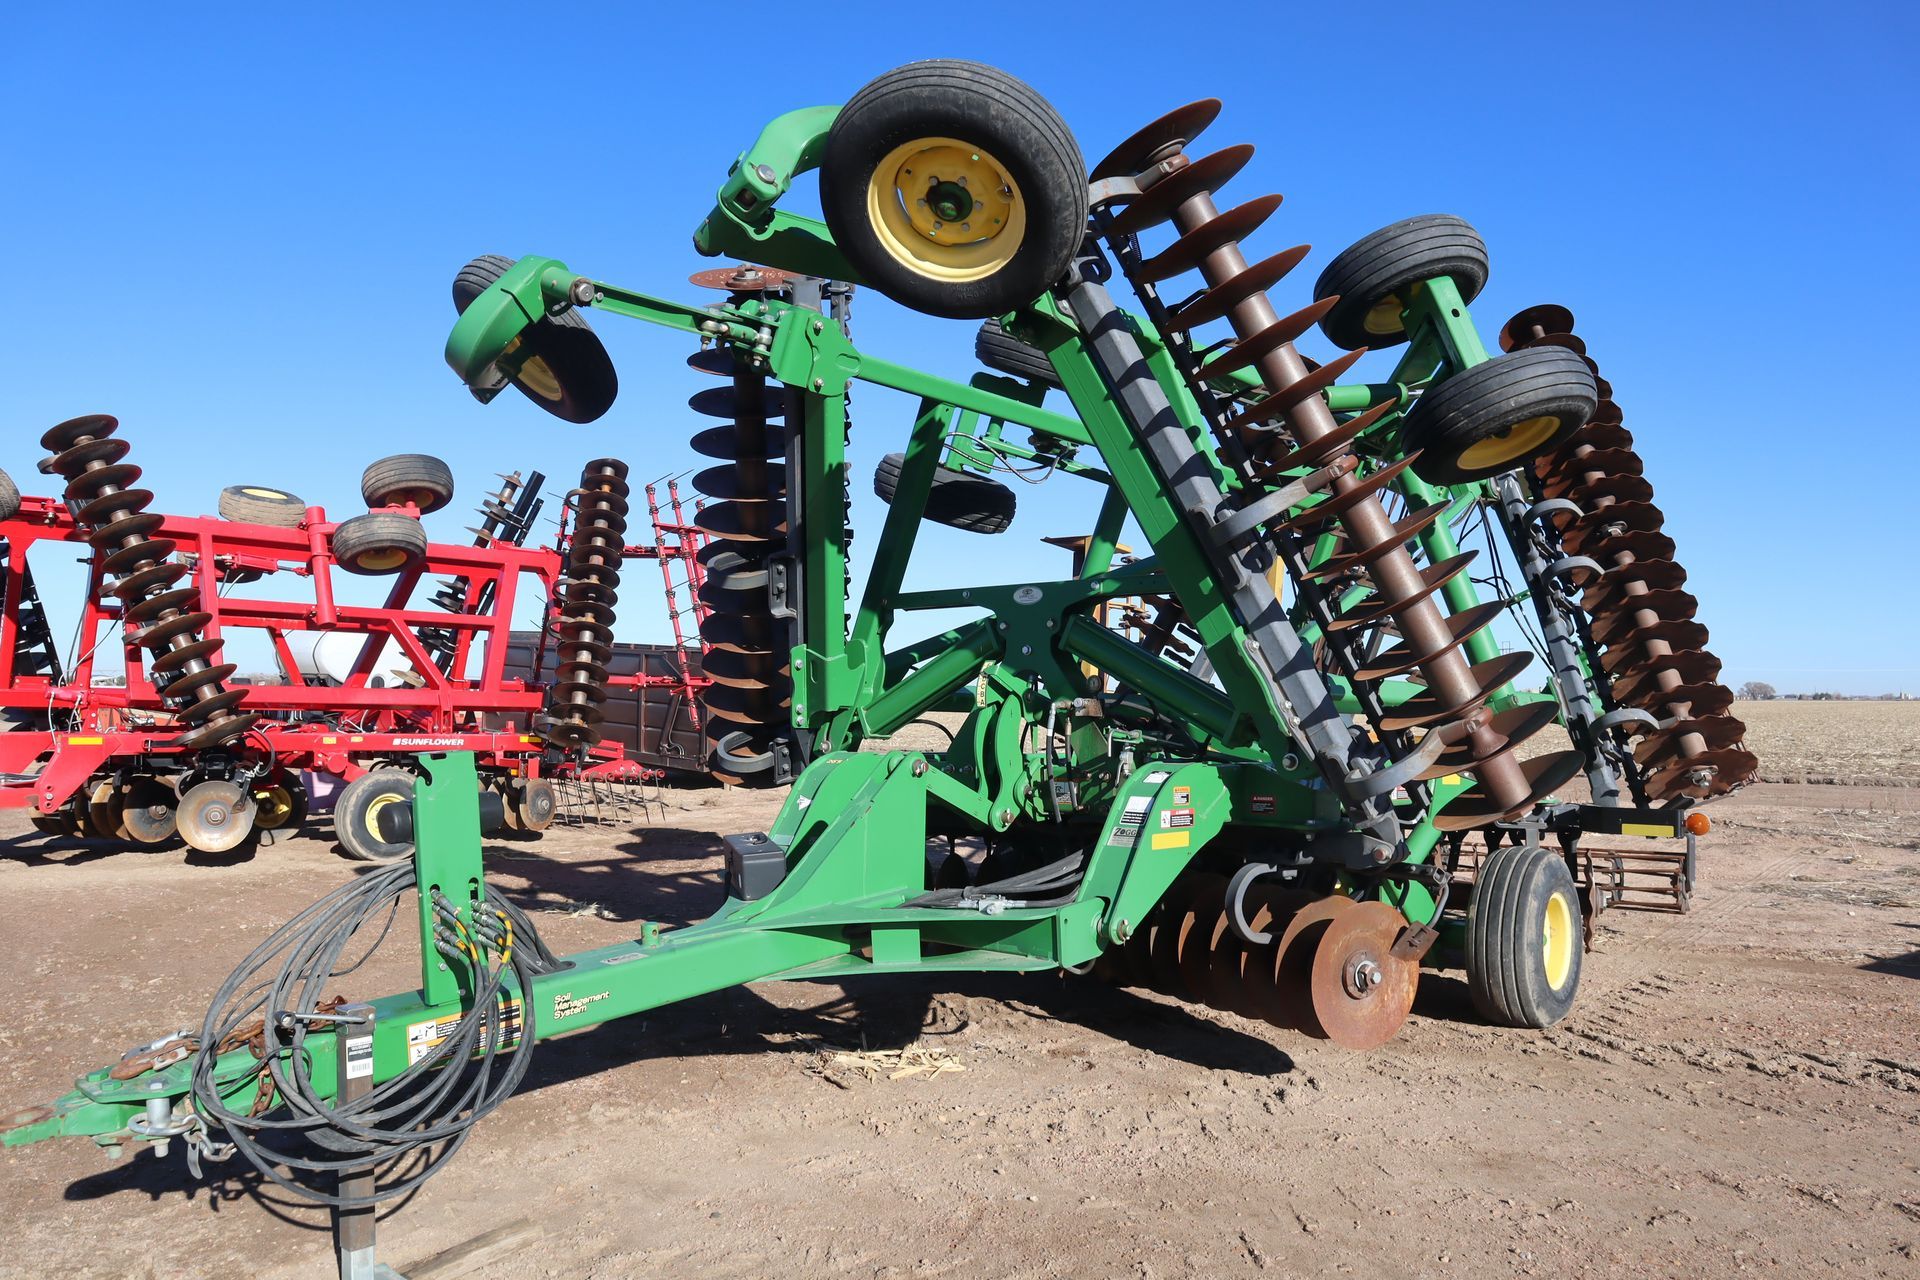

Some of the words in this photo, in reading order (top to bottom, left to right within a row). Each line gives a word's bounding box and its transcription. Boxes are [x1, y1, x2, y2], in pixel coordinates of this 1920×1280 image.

[401, 738, 464, 746] SUNFLOWER
[554, 992, 571, 1003] Soil
[554, 991, 610, 1011] Management
[554, 1005, 587, 1019] System
